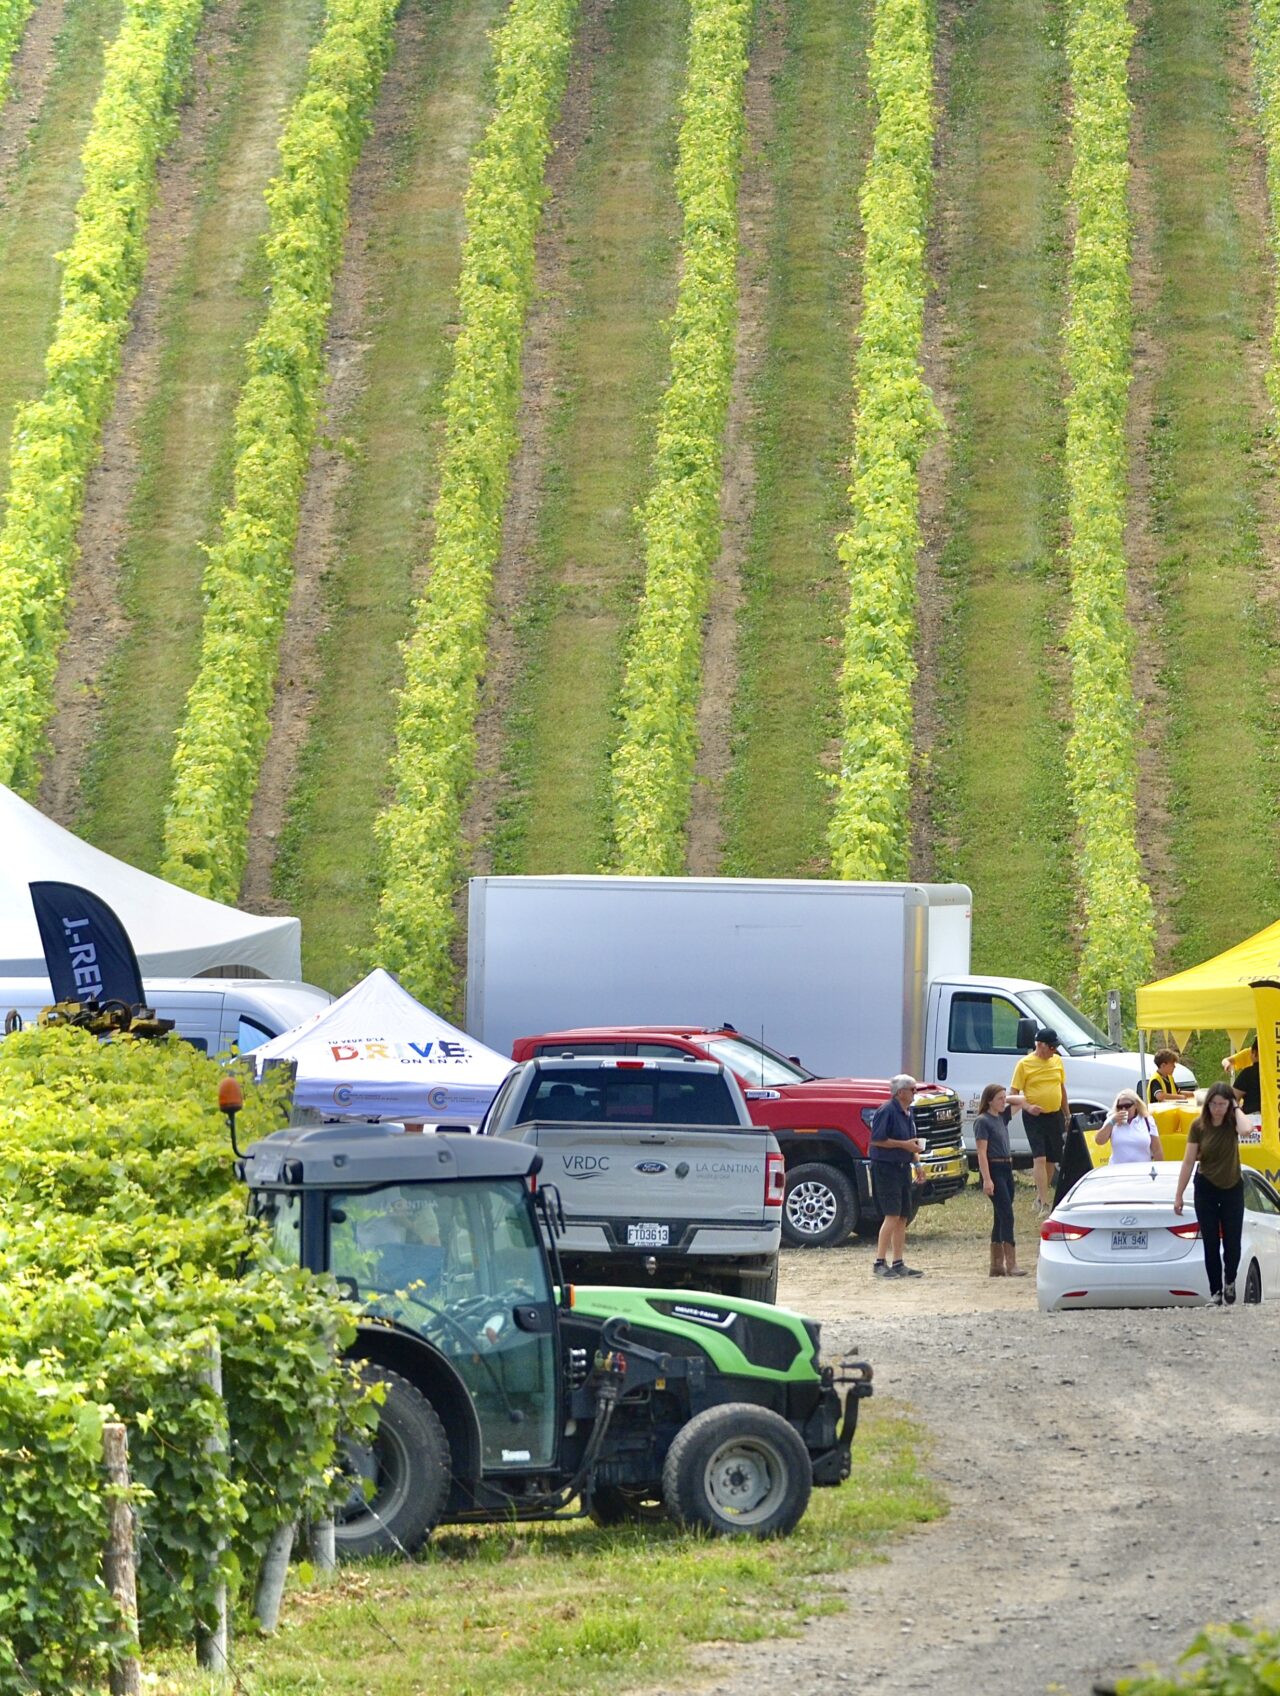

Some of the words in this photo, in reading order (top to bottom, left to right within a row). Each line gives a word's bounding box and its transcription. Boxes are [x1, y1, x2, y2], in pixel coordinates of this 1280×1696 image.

[562, 1155, 610, 1171] VRDC
[642, 1163, 661, 1173] Ford
[695, 1162, 711, 1173] LA
[714, 1162, 760, 1174] CANTINA
[628, 1229, 668, 1240] FTD3613
